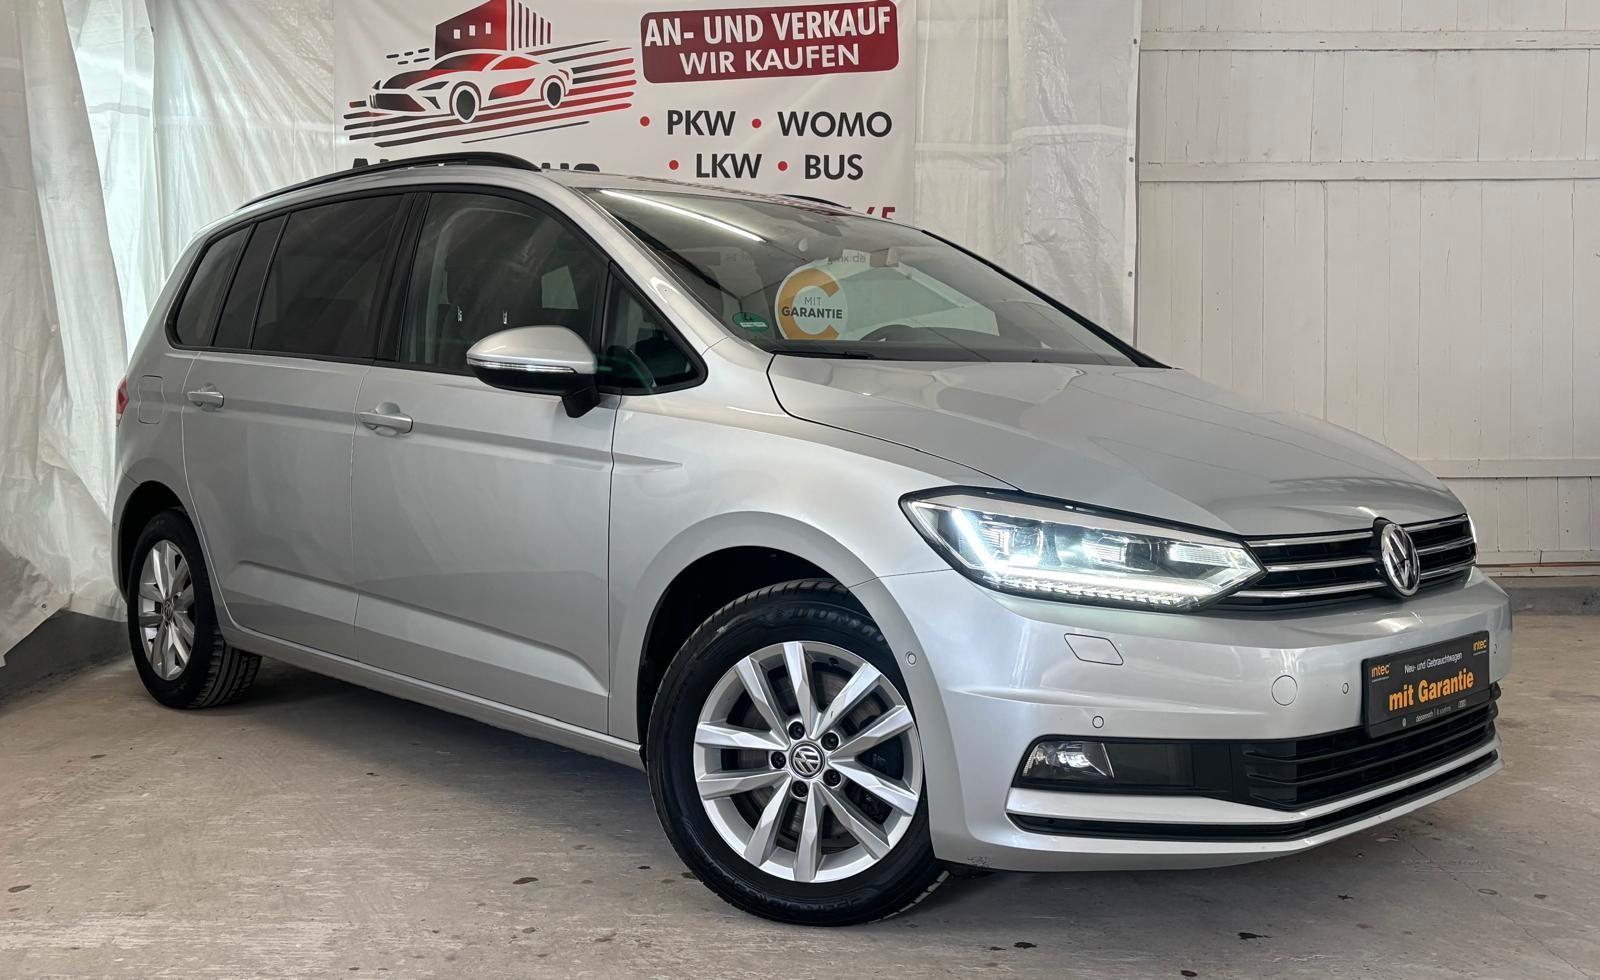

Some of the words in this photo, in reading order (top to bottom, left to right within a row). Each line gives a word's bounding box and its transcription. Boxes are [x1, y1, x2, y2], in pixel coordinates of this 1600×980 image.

[645, 18, 694, 47] AN-
[704, 14, 764, 45] UND
[771, 6, 891, 41] VERKAUF
[679, 50, 736, 75] WIR
[746, 43, 860, 72] KAUFEN
[667, 109, 736, 136] PKW
[777, 110, 893, 138] WOMO
[696, 153, 762, 179] LKW
[804, 153, 864, 181] BUS
[781, 306, 843, 319] GARANTIE
[804, 296, 822, 306] MIT
[1417, 661, 1426, 671] und
[1426, 652, 1463, 669] Gebrauchtwagen
[1388, 684, 1415, 711] mit
[1418, 668, 1475, 703] Garantie
